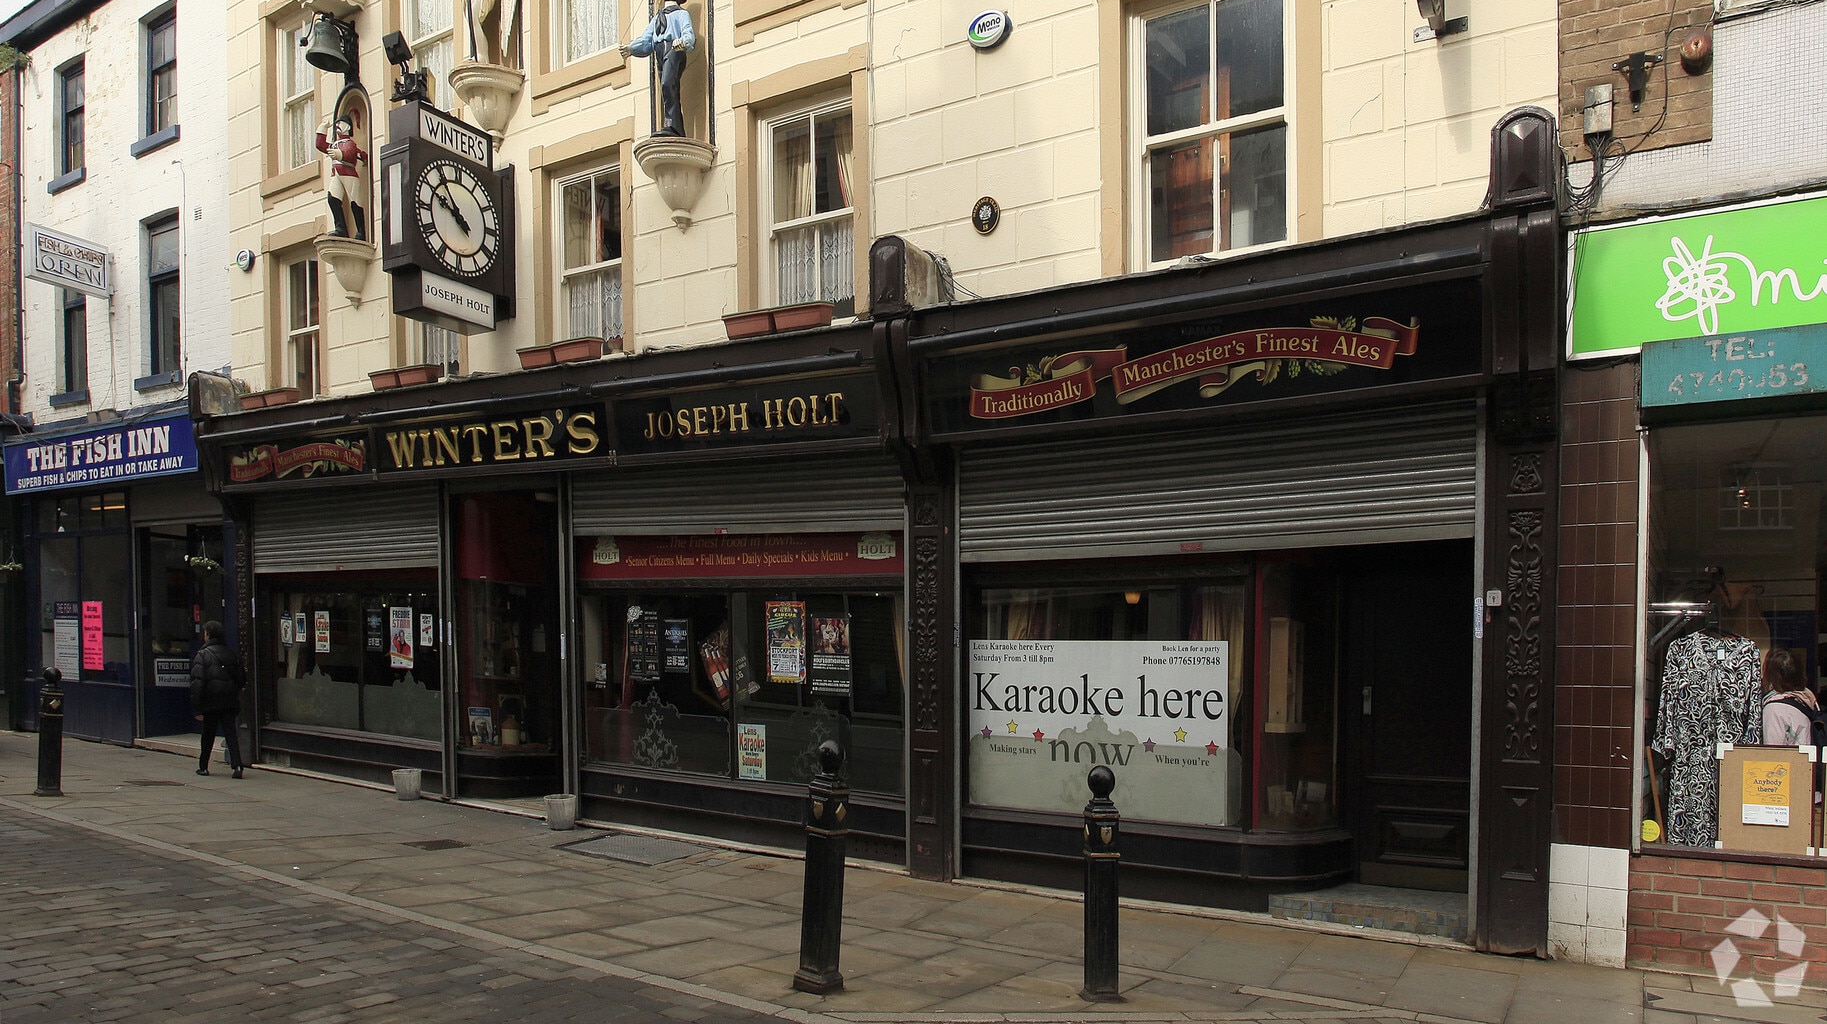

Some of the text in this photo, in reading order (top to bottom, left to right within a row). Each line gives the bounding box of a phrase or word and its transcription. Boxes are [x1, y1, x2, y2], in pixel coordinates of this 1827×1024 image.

[977, 17, 1001, 34] Mono
[424, 114, 485, 162] WINTER'S
[38, 236, 103, 265] FISH & CHIPS
[42, 254, 101, 286] OPEN
[425, 284, 490, 315] JOSEPH HOLT
[1122, 333, 1381, 386] Manchester's Finest Ales
[982, 380, 1082, 414] Traditionally
[644, 392, 843, 439] JOSEPH HOLT
[386, 408, 599, 468] WINTER'S
[27, 425, 170, 472] THE FISH INN
[343, 451, 359, 466] Ales
[18, 456, 183, 489] SUPERB FISH & CHIPS TO EAT IN OR TAKE AWAY
[595, 552, 618, 560] HOLT
[649, 555, 674, 566] Citizens
[676, 555, 694, 566] Menu
[700, 554, 714, 566] Full
[716, 554, 735, 565] Menu
[742, 552, 761, 567] Daily
[763, 551, 794, 566] Specials
[801, 550, 818, 562] Kids
[820, 550, 843, 562] Menu
[860, 544, 894, 555] HOLT
[990, 642, 1017, 650] Karaoke
[1018, 643, 1033, 651] here
[1035, 643, 1054, 652] Every
[773, 663, 779, 671] 7
[973, 653, 1054, 664] Saturday From 3 till 8pm
[1143, 656, 1221, 665] Phone 07765197848
[973, 672, 1224, 720] Karaoke here
[744, 726, 757, 735] Lens
[739, 733, 765, 752] Karaoke
[989, 743, 1037, 755] Making stars
[1048, 739, 1135, 766] now
[1155, 754, 1210, 768] When you're
[1753, 779, 1783, 787] Anybody
